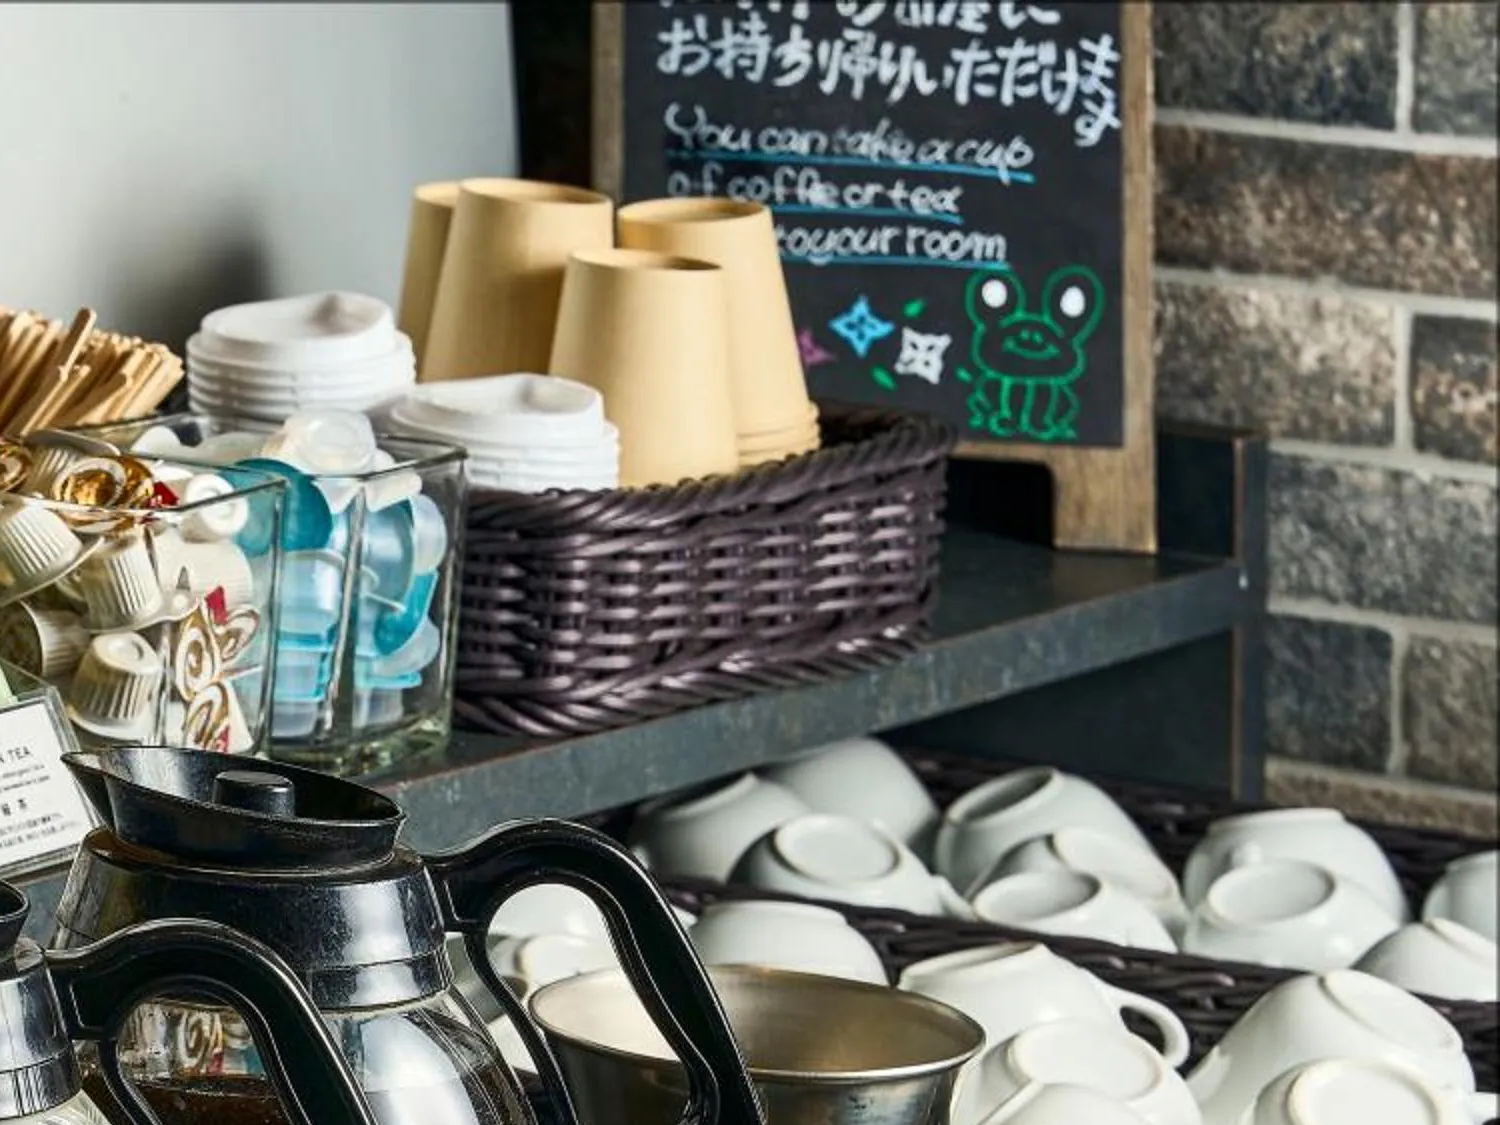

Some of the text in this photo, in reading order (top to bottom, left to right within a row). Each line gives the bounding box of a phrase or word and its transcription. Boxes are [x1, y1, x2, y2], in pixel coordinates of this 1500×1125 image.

[665, 101, 750, 152] You
[758, 125, 828, 156] can
[955, 135, 1036, 186] cup
[888, 180, 963, 214] tea
[904, 226, 1008, 261] room
